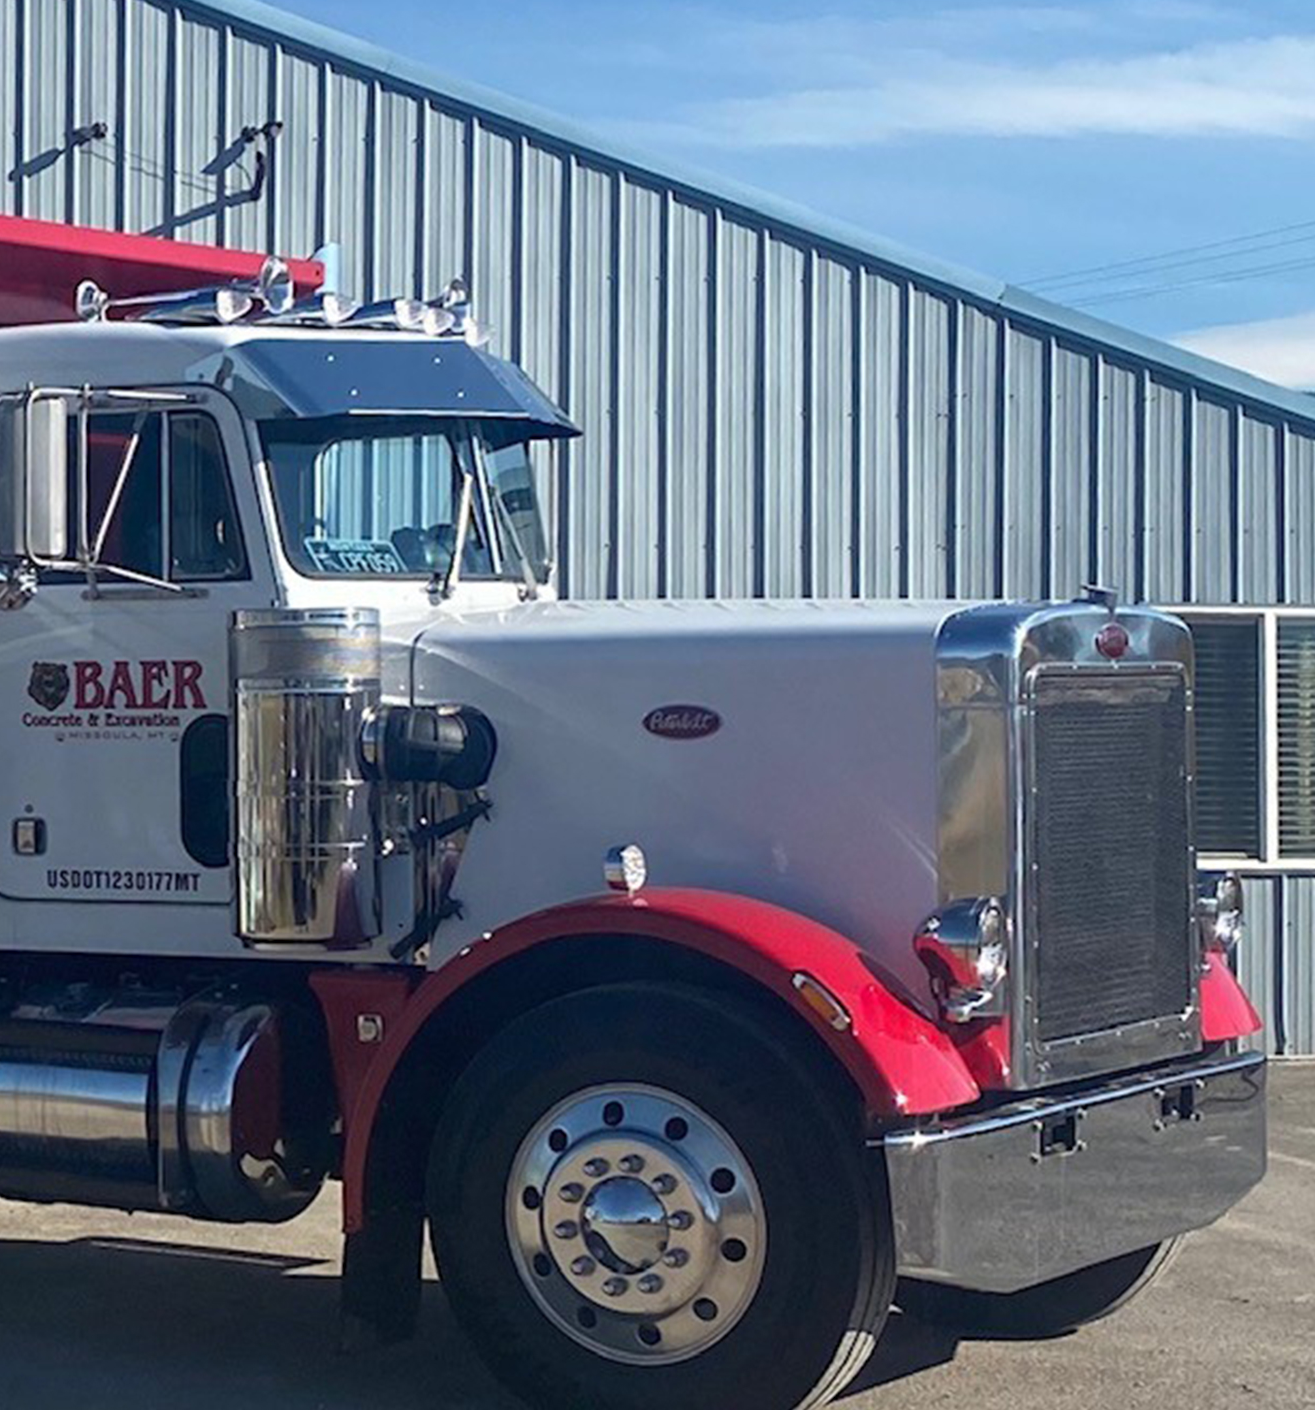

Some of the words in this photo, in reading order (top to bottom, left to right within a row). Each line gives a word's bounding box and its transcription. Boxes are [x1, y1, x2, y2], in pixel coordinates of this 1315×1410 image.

[73, 660, 208, 709] BAER
[22, 712, 83, 727] Concrete
[87, 712, 99, 727] &
[105, 712, 180, 727] Excavation
[68, 731, 143, 741] MISSOULA,
[148, 731, 166, 740] MT
[47, 869, 201, 892] USDOT1230177MT
